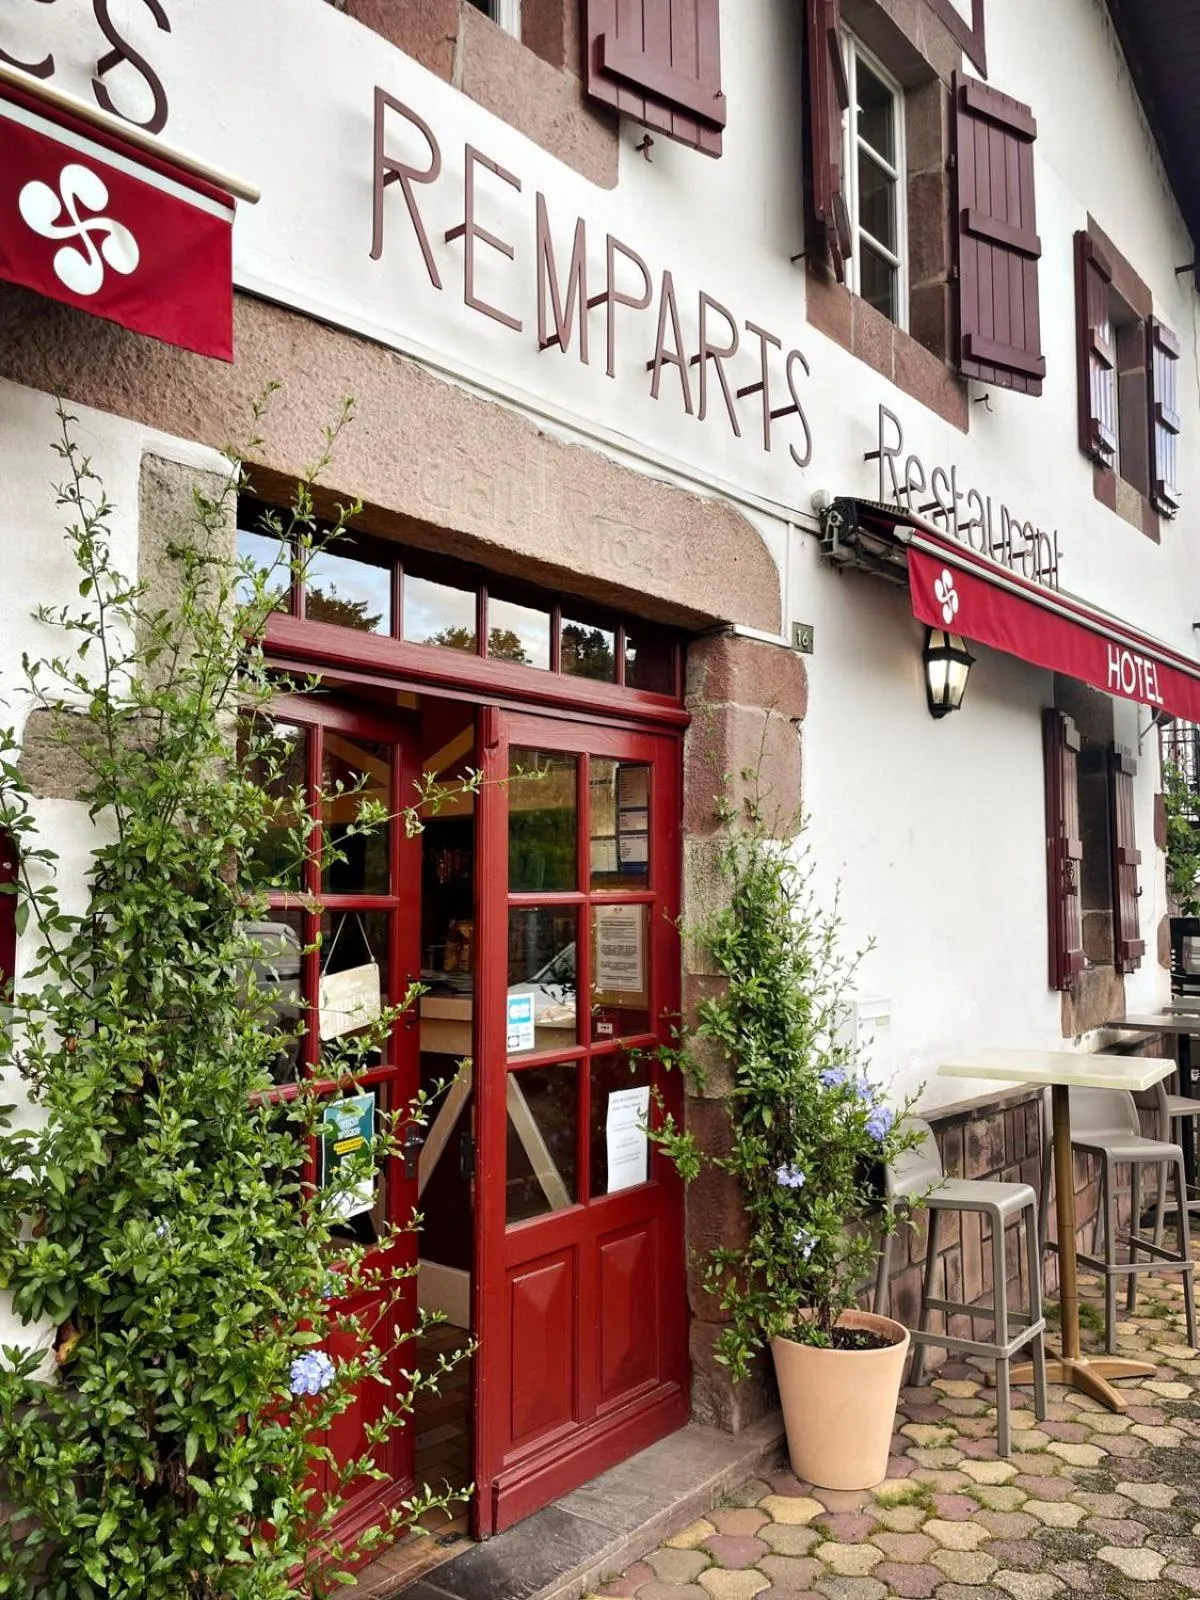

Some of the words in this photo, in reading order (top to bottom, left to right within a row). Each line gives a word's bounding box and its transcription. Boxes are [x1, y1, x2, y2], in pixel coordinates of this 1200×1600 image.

[369, 85, 812, 467] REMPARTS
[878, 403, 1064, 591] Restaurant
[797, 630, 809, 647] 16
[1107, 643, 1164, 704] HOTEL
